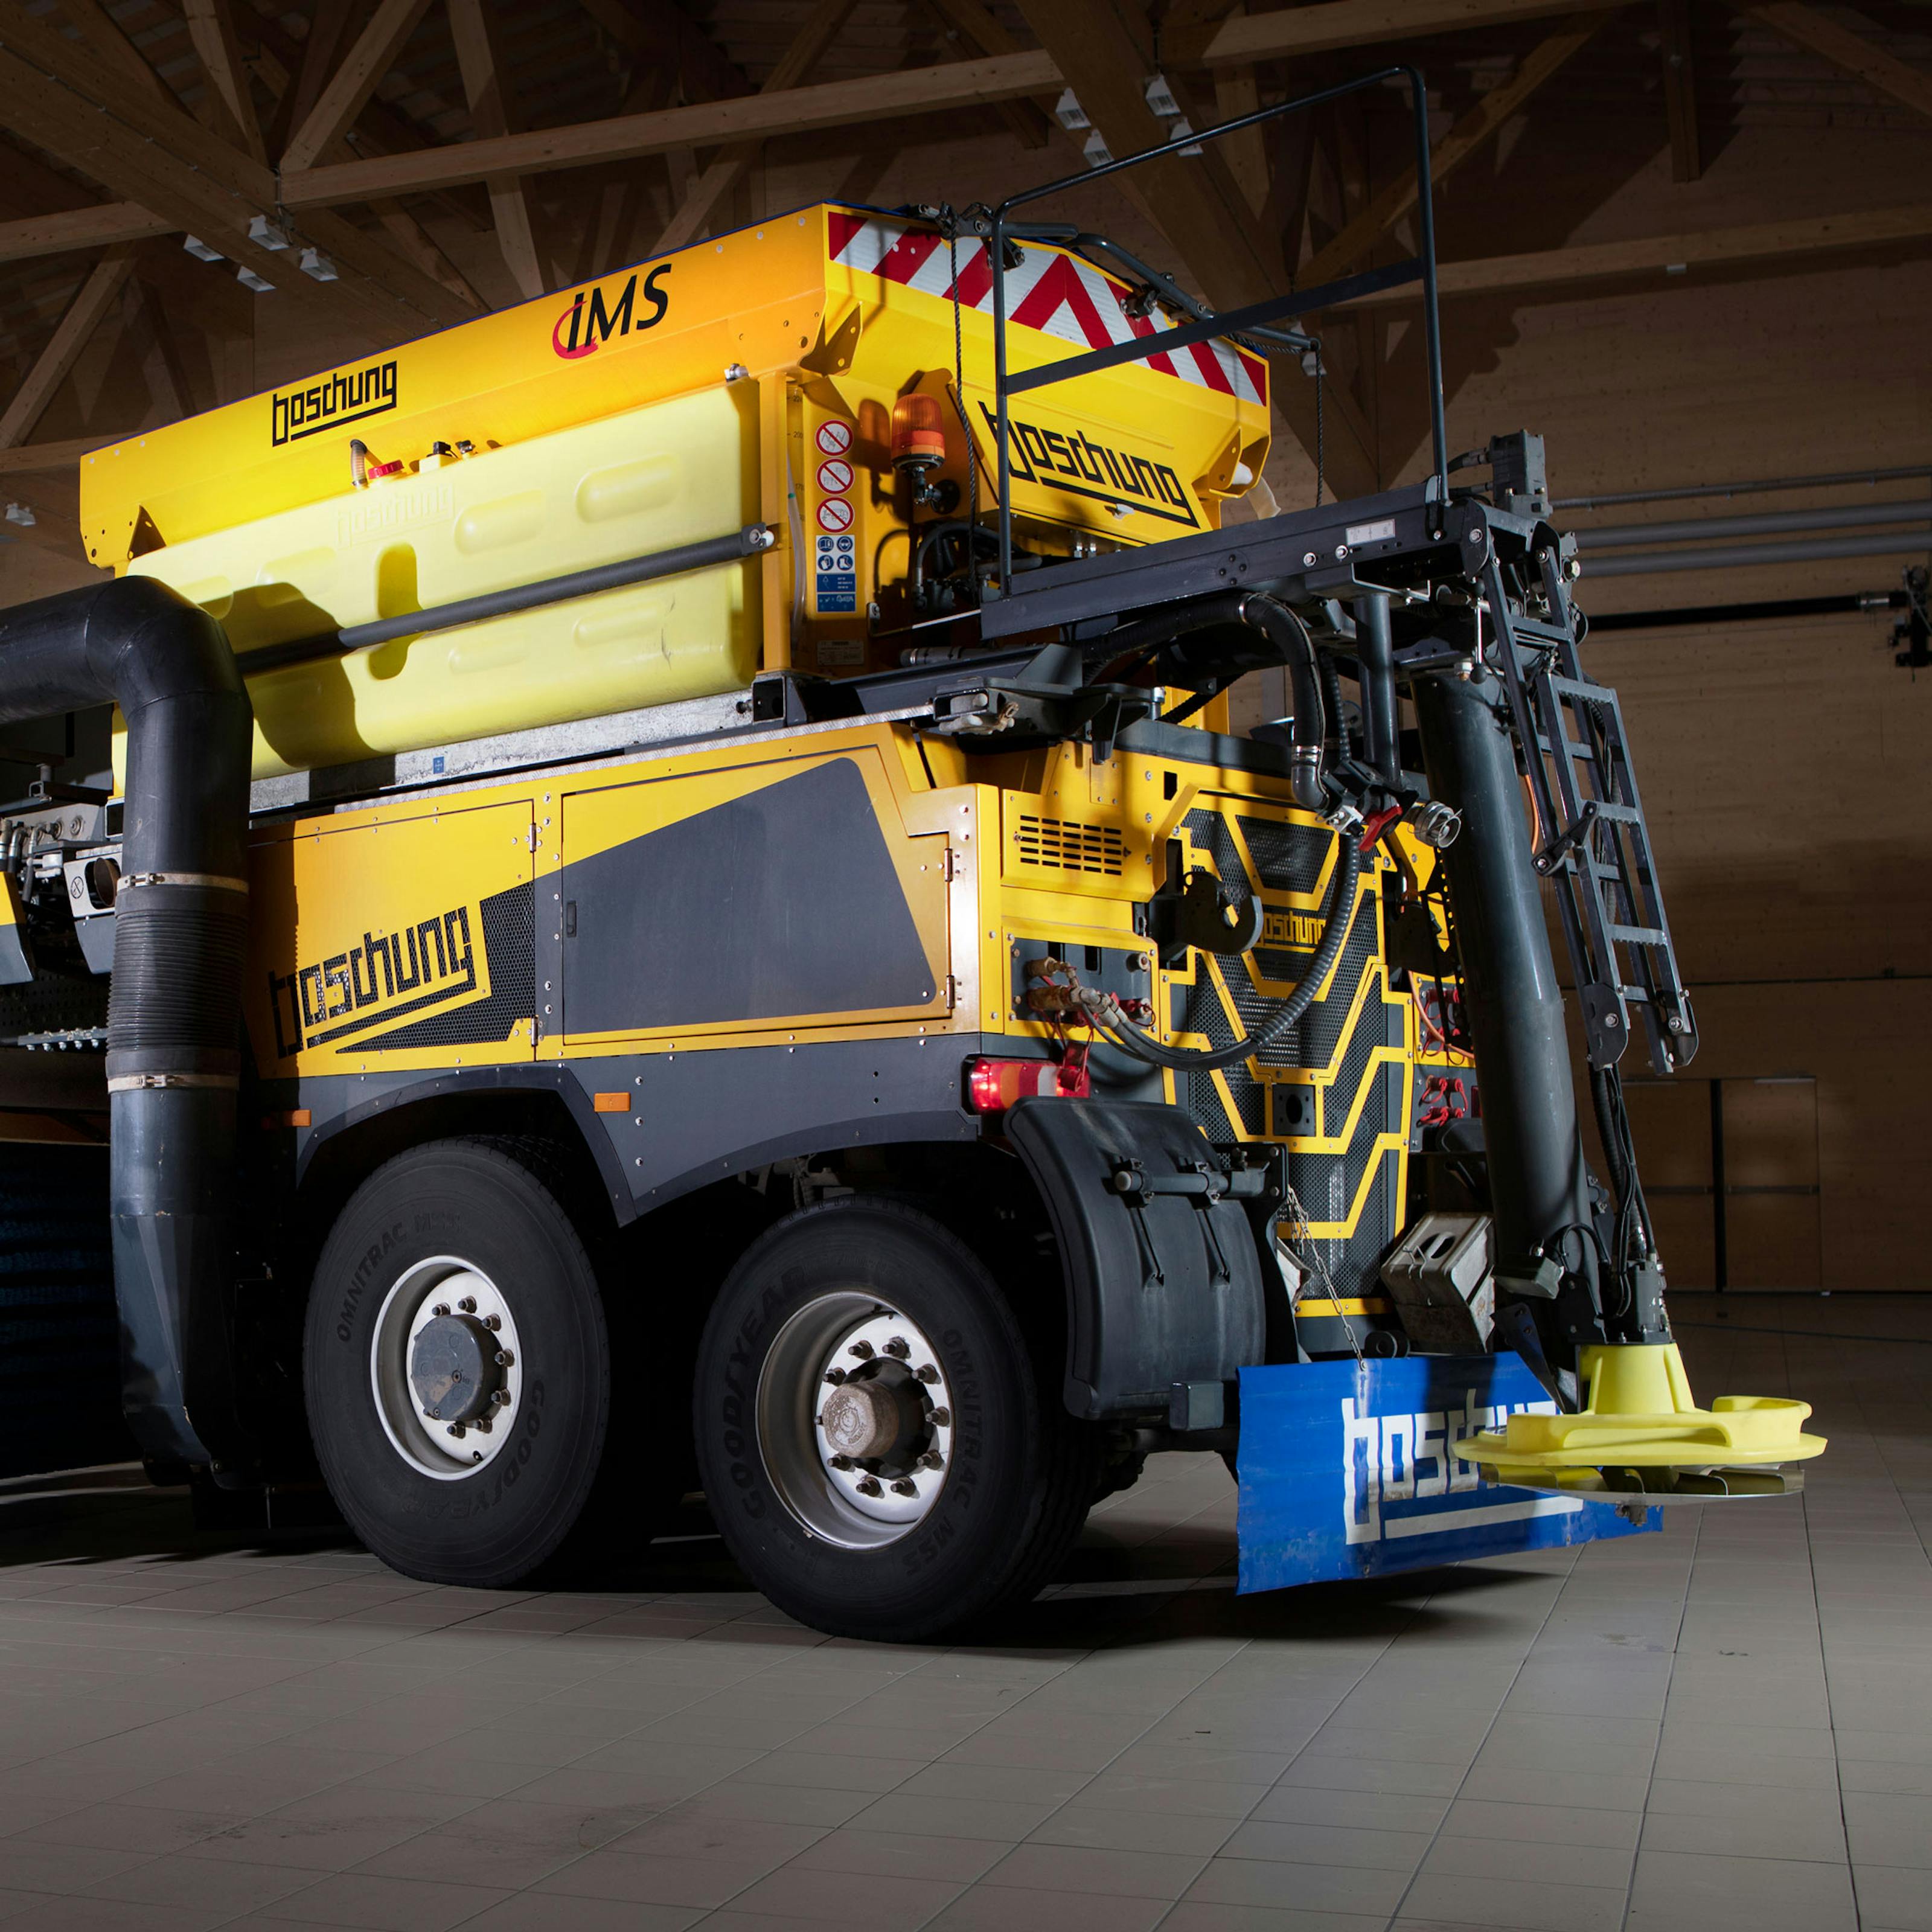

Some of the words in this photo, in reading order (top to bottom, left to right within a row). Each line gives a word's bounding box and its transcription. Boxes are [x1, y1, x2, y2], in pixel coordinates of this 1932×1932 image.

[272, 360, 397, 447] boschung
[269, 906, 478, 1059] boschung
[336, 1222, 407, 1343] OMNITRAC
